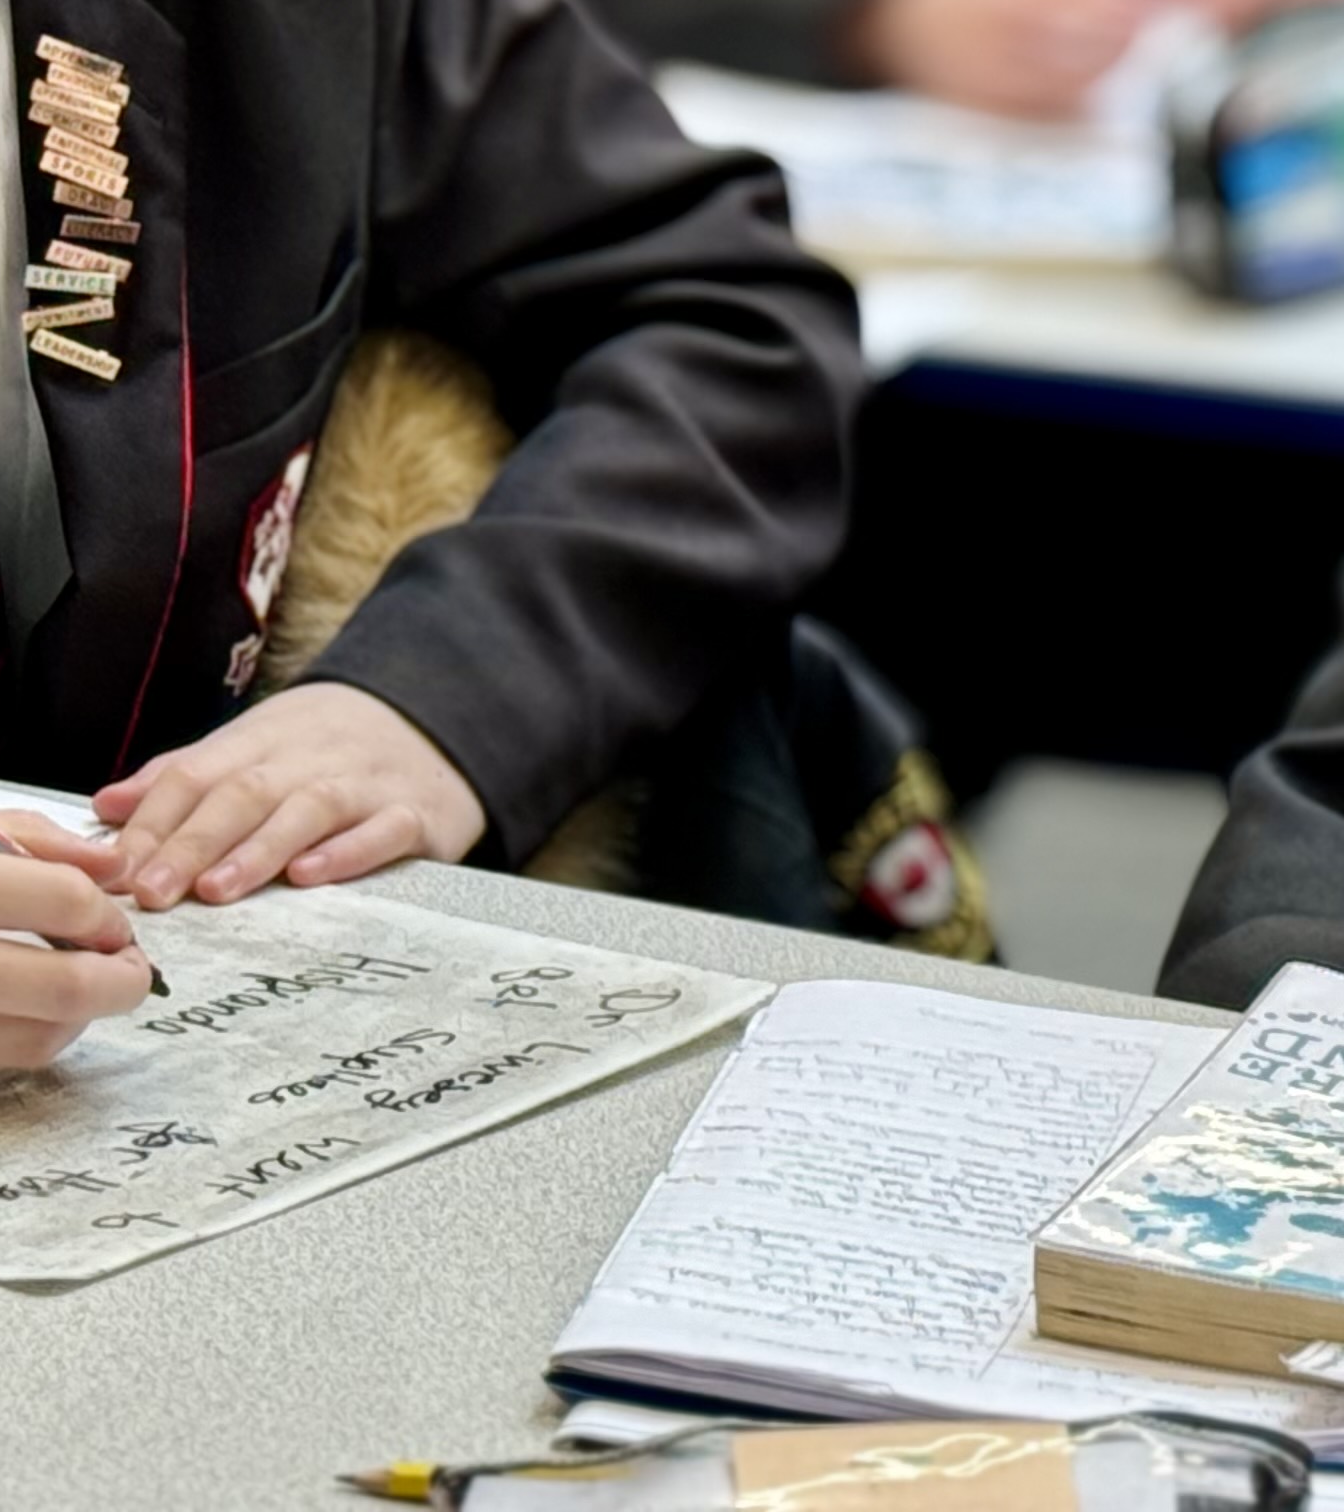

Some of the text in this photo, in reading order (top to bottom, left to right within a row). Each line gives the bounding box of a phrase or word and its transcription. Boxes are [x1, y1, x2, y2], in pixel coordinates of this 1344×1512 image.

[52, 157, 117, 190] SPORTS
[32, 271, 106, 292] SERVICE
[36, 335, 114, 372] LEADERSHIP
